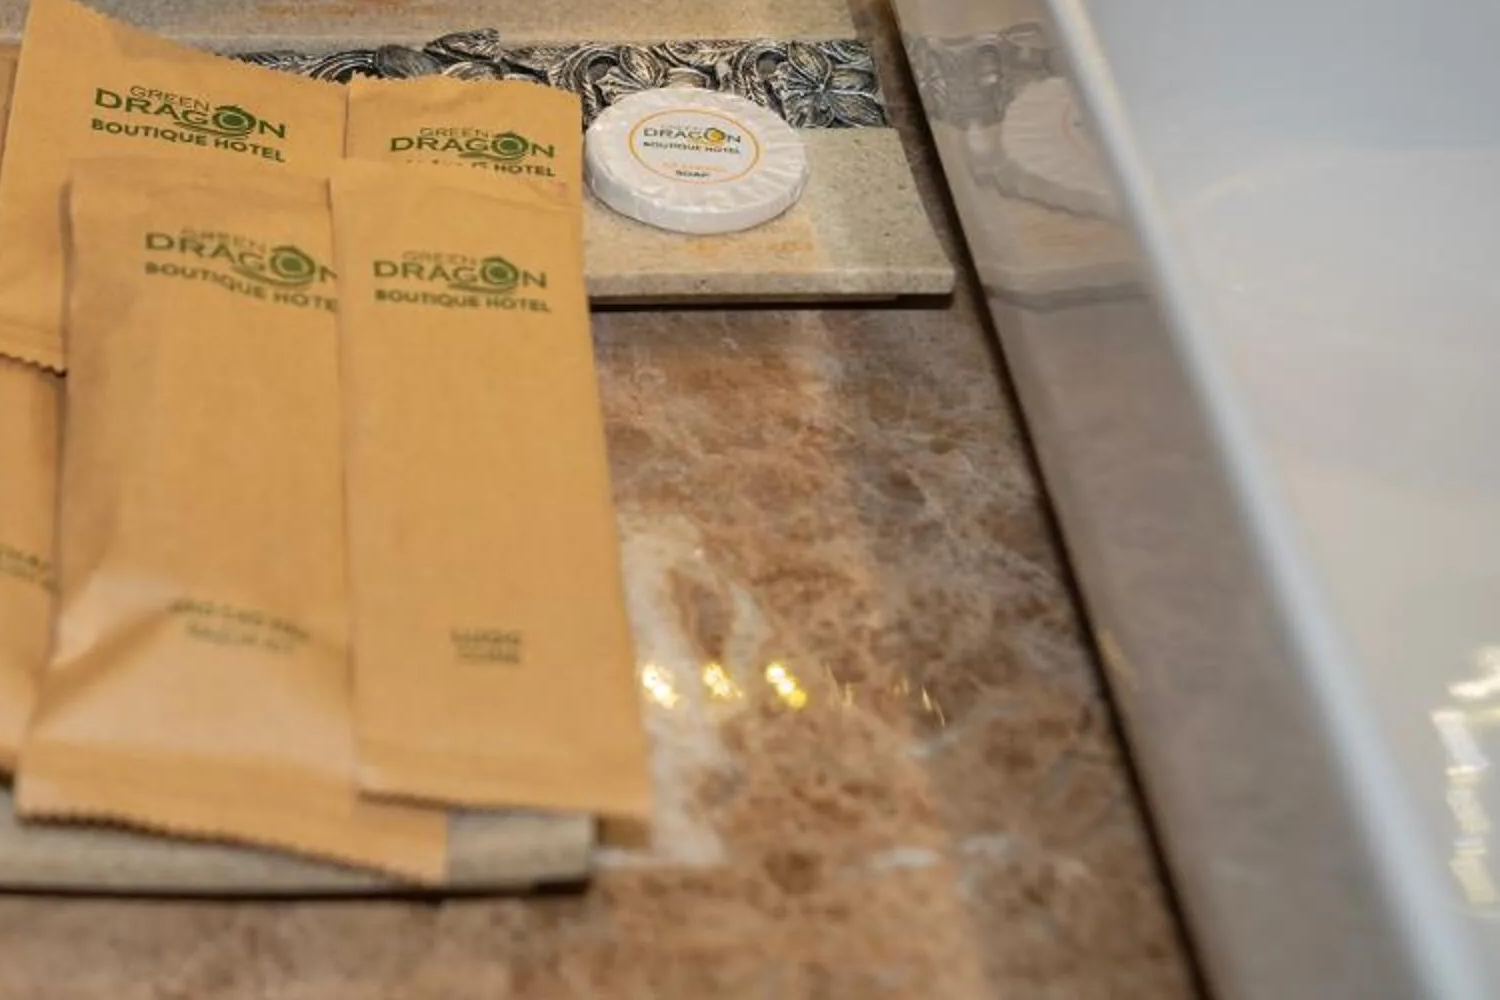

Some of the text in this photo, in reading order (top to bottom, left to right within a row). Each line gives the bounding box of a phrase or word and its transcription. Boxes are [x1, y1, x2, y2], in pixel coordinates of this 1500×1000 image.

[130, 85, 209, 112] GREEN
[95, 88, 286, 139] DRAGON
[91, 118, 286, 163] BOUTIQUE HOTEL
[390, 131, 556, 158] DRAGON
[419, 127, 489, 139] GREEN
[643, 127, 742, 144] DRAGON
[494, 162, 557, 177] HOTEL
[373, 256, 548, 289] DRAGON
[145, 261, 338, 314] BOUTIQUE HOTE
[375, 289, 552, 313] BOUTIQUE HOTEL
